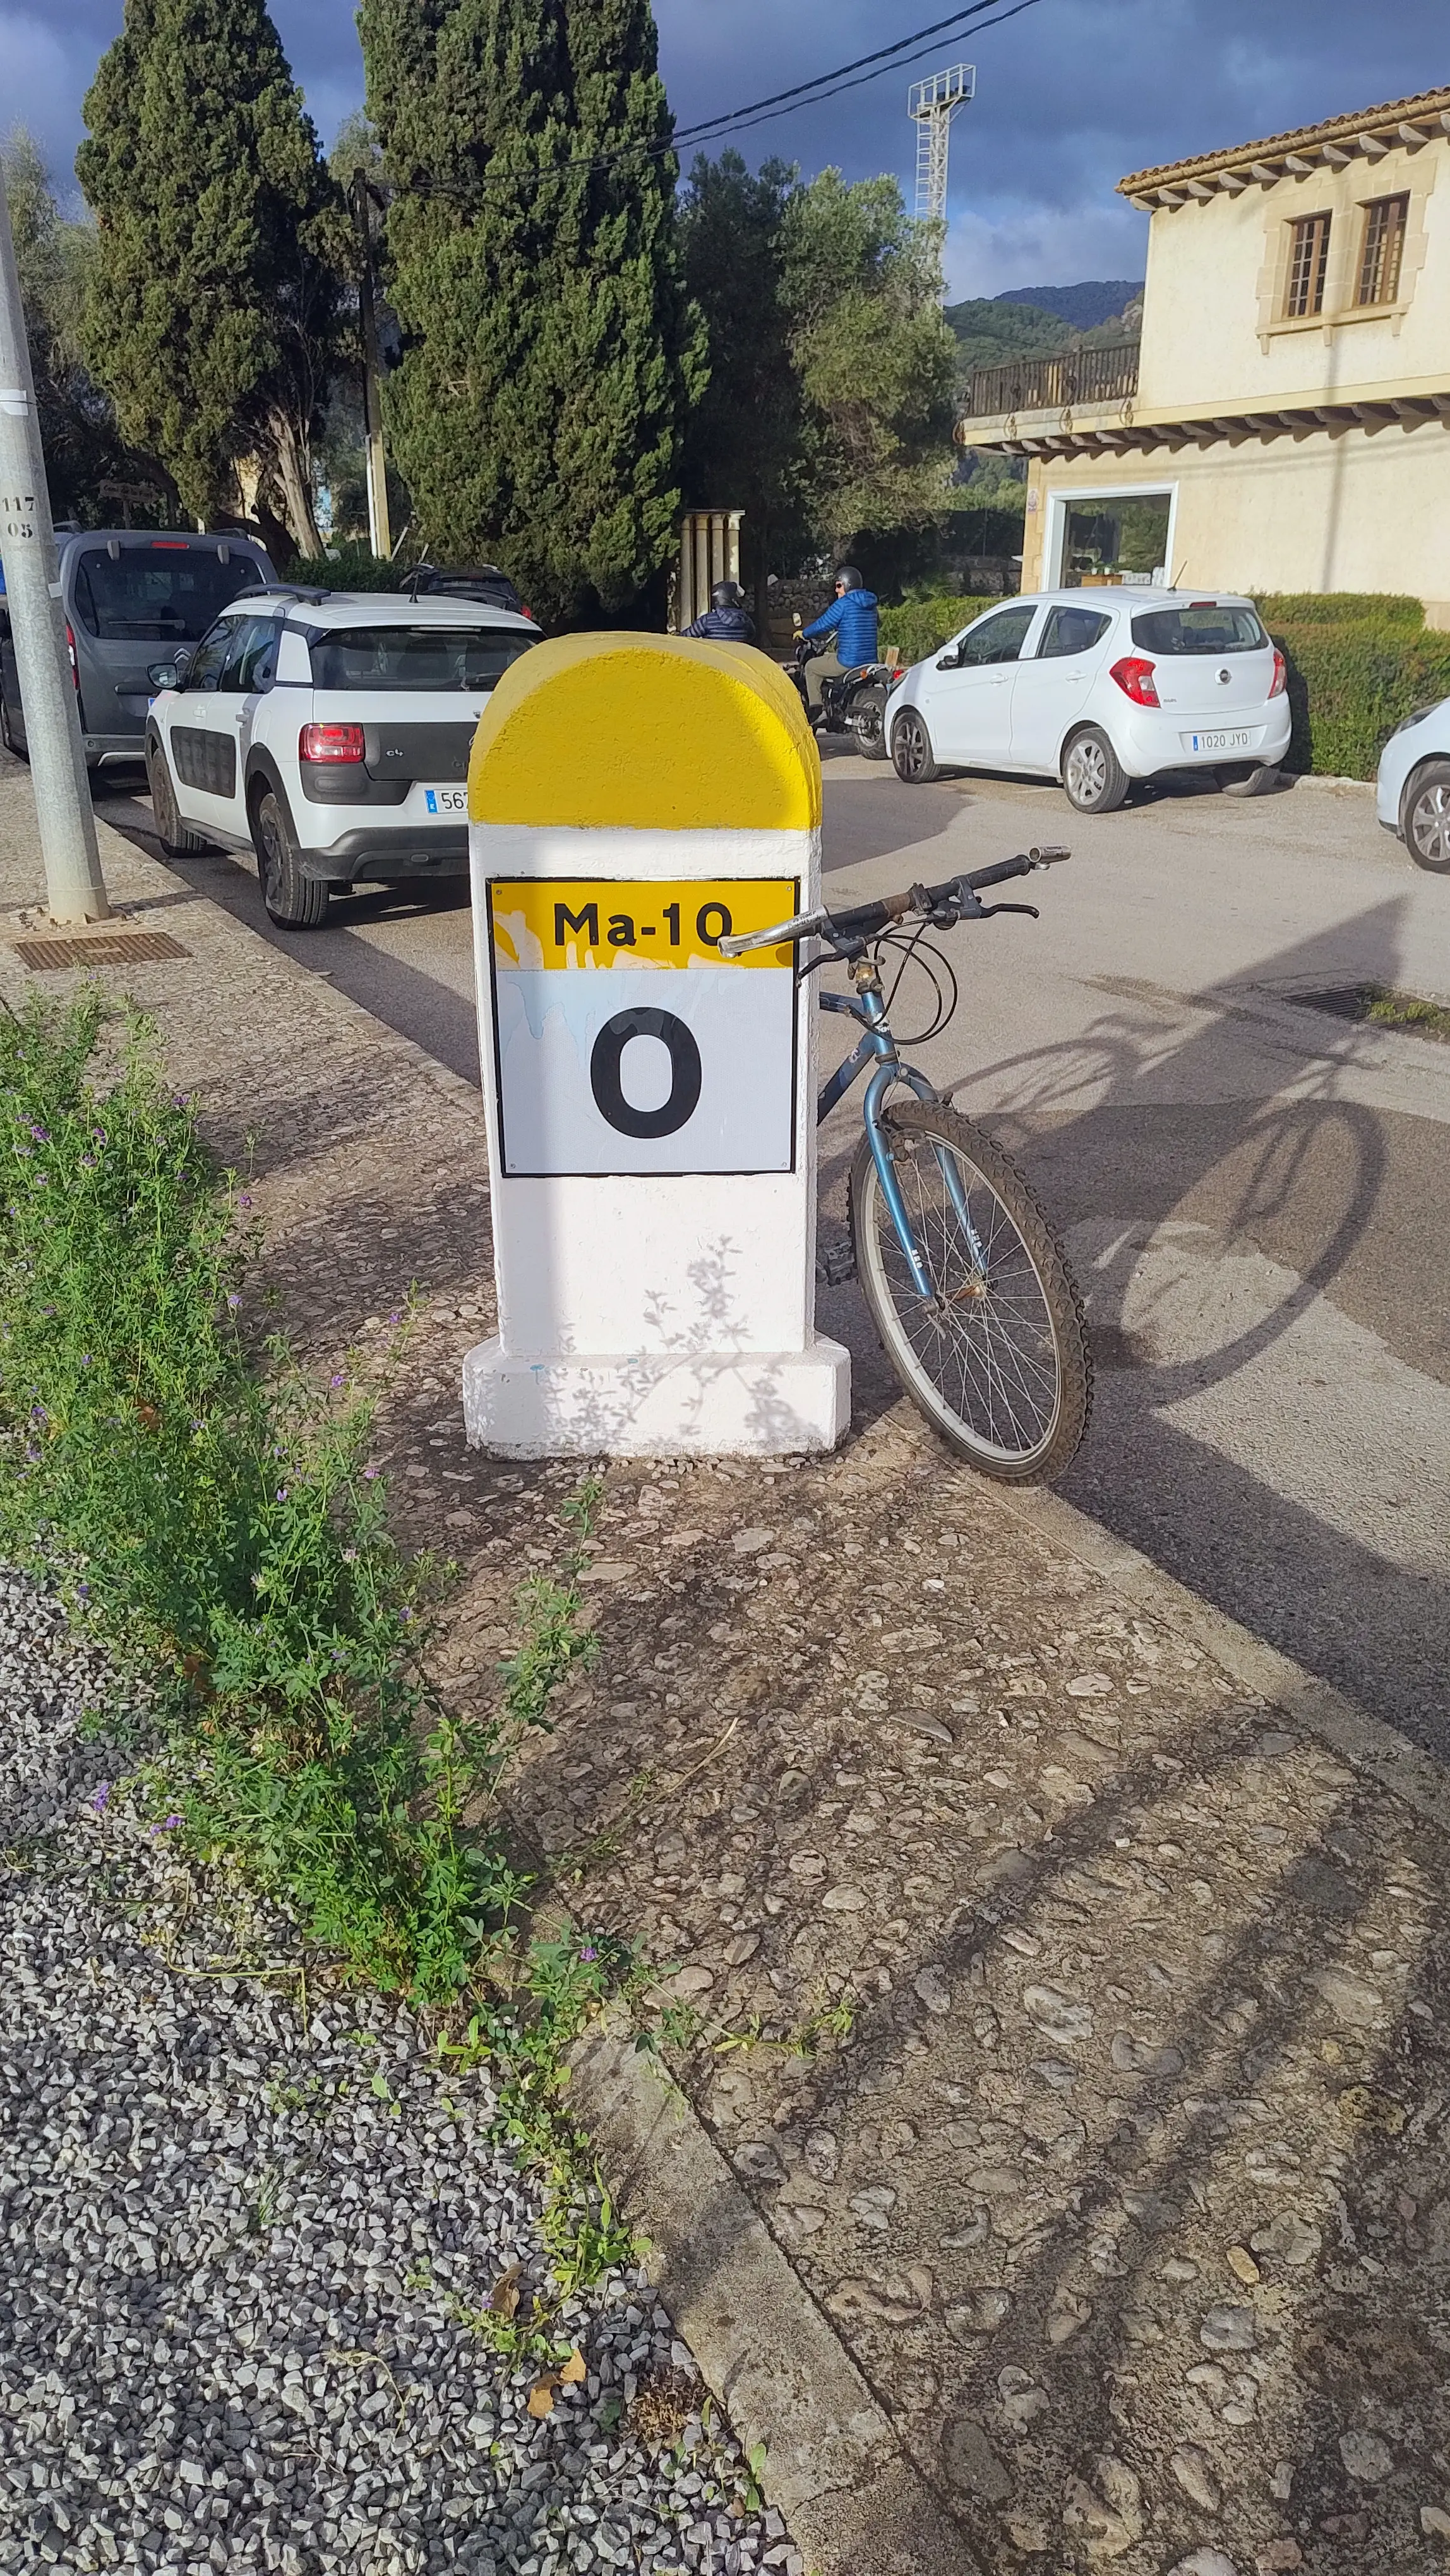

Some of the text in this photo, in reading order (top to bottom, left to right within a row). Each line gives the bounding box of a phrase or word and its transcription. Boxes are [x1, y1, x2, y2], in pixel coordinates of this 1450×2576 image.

[3, 497, 35, 511] 117
[8, 523, 33, 539] 05
[1201, 735, 1226, 748] 1020
[1230, 732, 1248, 746] JYD
[554, 902, 733, 946] Ma-10
[590, 1006, 702, 1139] 0
